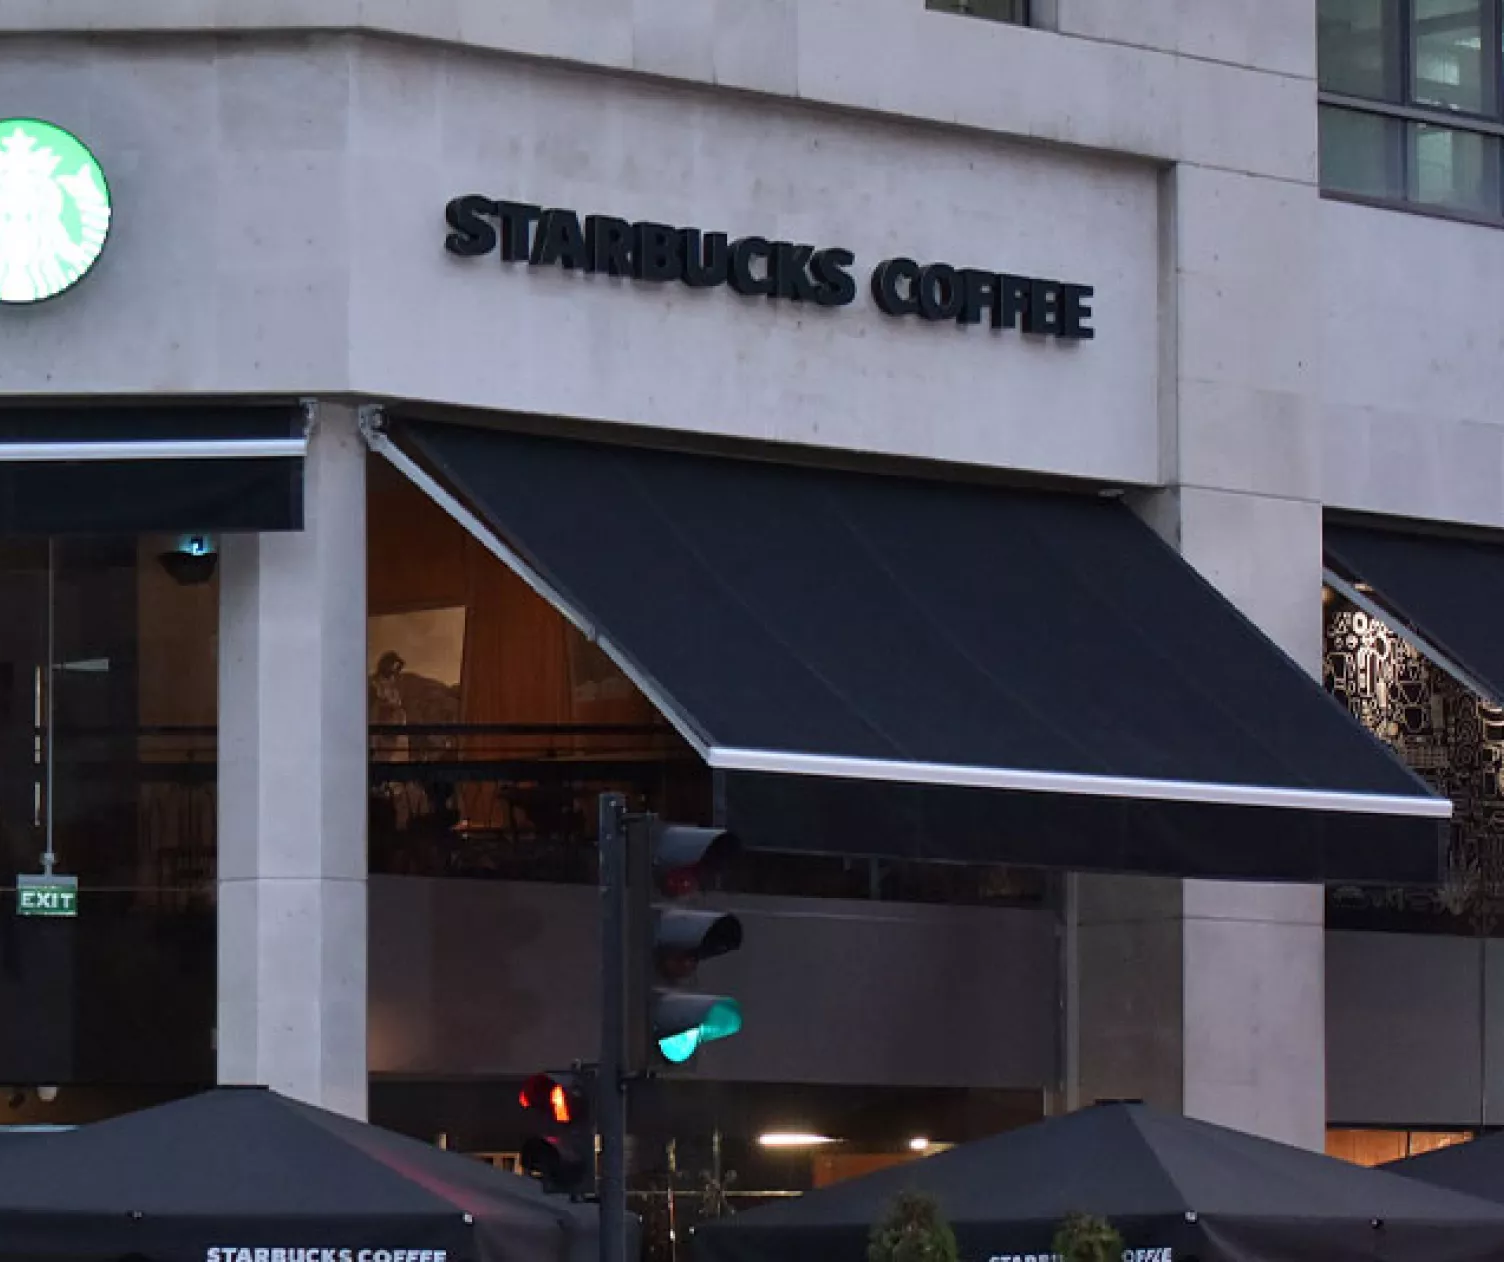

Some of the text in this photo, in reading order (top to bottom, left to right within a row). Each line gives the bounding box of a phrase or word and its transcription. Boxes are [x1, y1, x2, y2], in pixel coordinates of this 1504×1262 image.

[445, 194, 1095, 339] STARBUCKS COFFEE
[21, 891, 74, 909] EXIT
